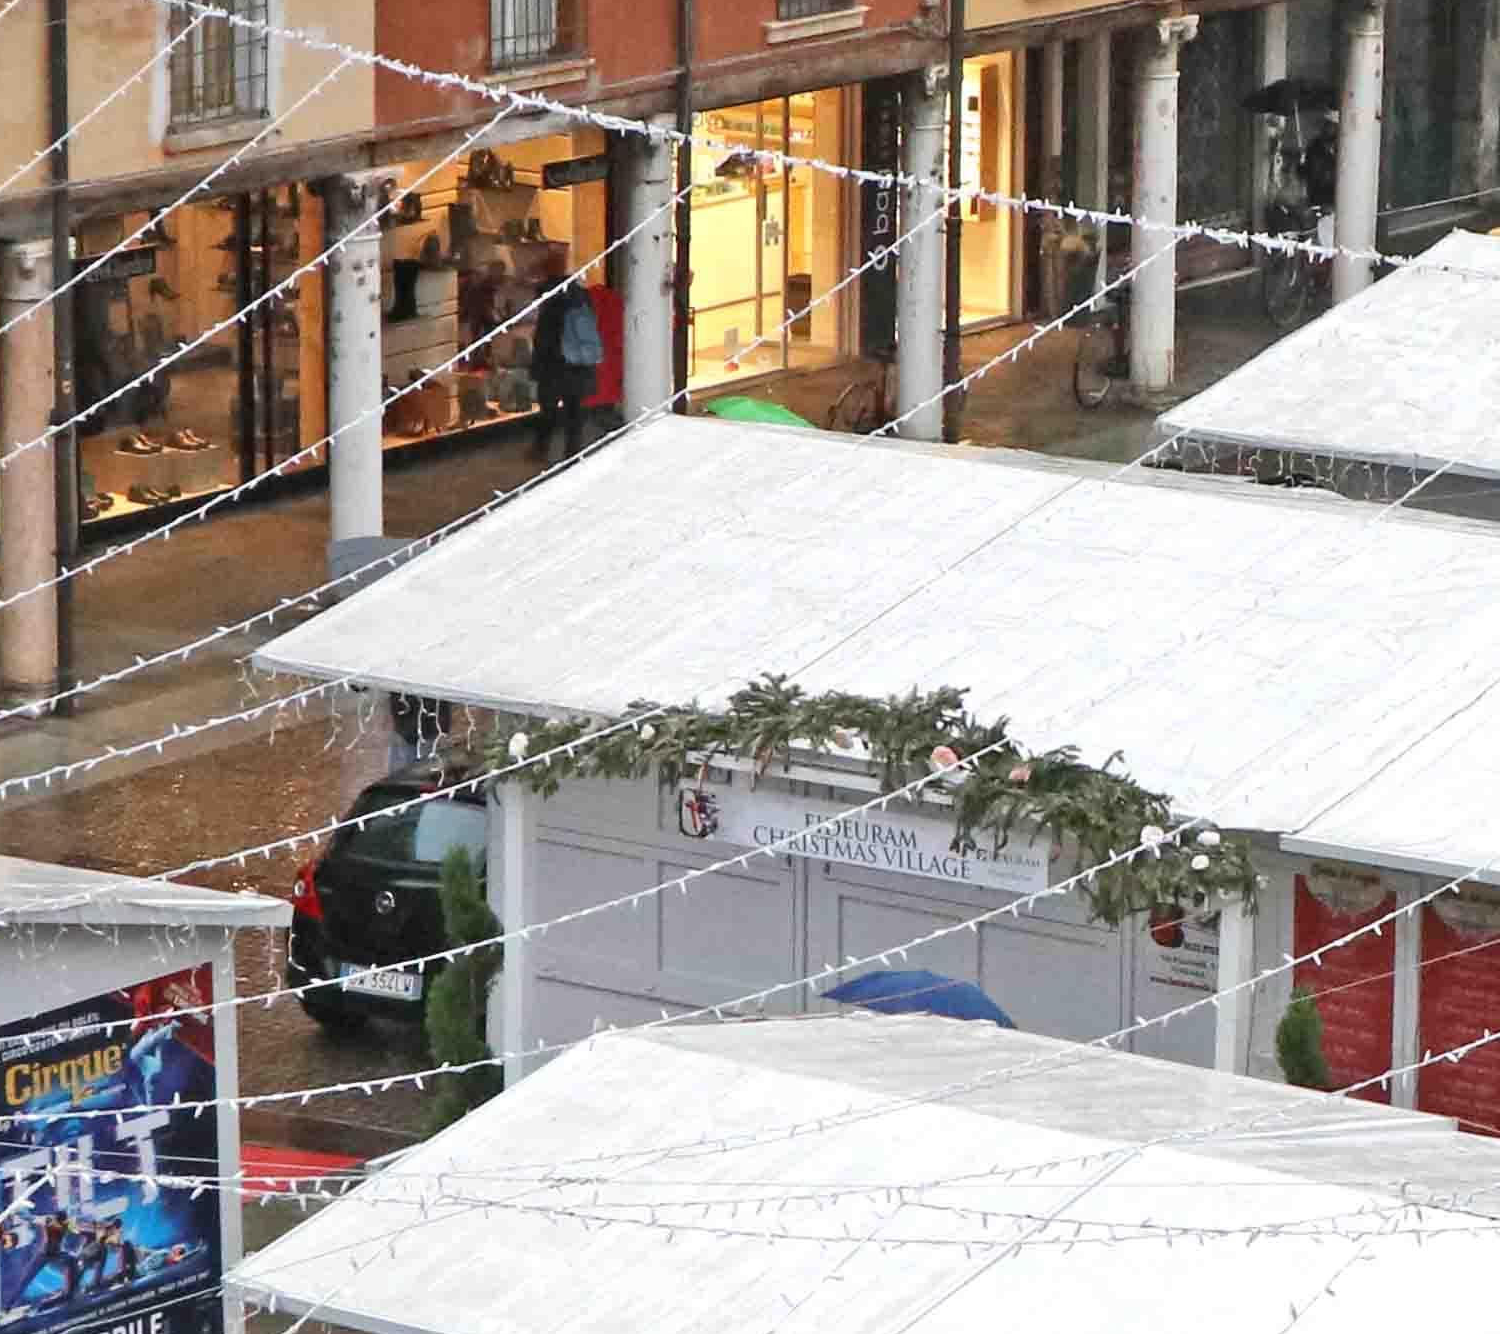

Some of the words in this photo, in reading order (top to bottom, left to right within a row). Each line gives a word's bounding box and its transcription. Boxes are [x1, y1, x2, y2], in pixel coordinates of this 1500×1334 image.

[753, 824, 877, 865] CHRISTMAS
[884, 851, 972, 880] VILLAGE
[5, 1043, 123, 1106] Cirque
